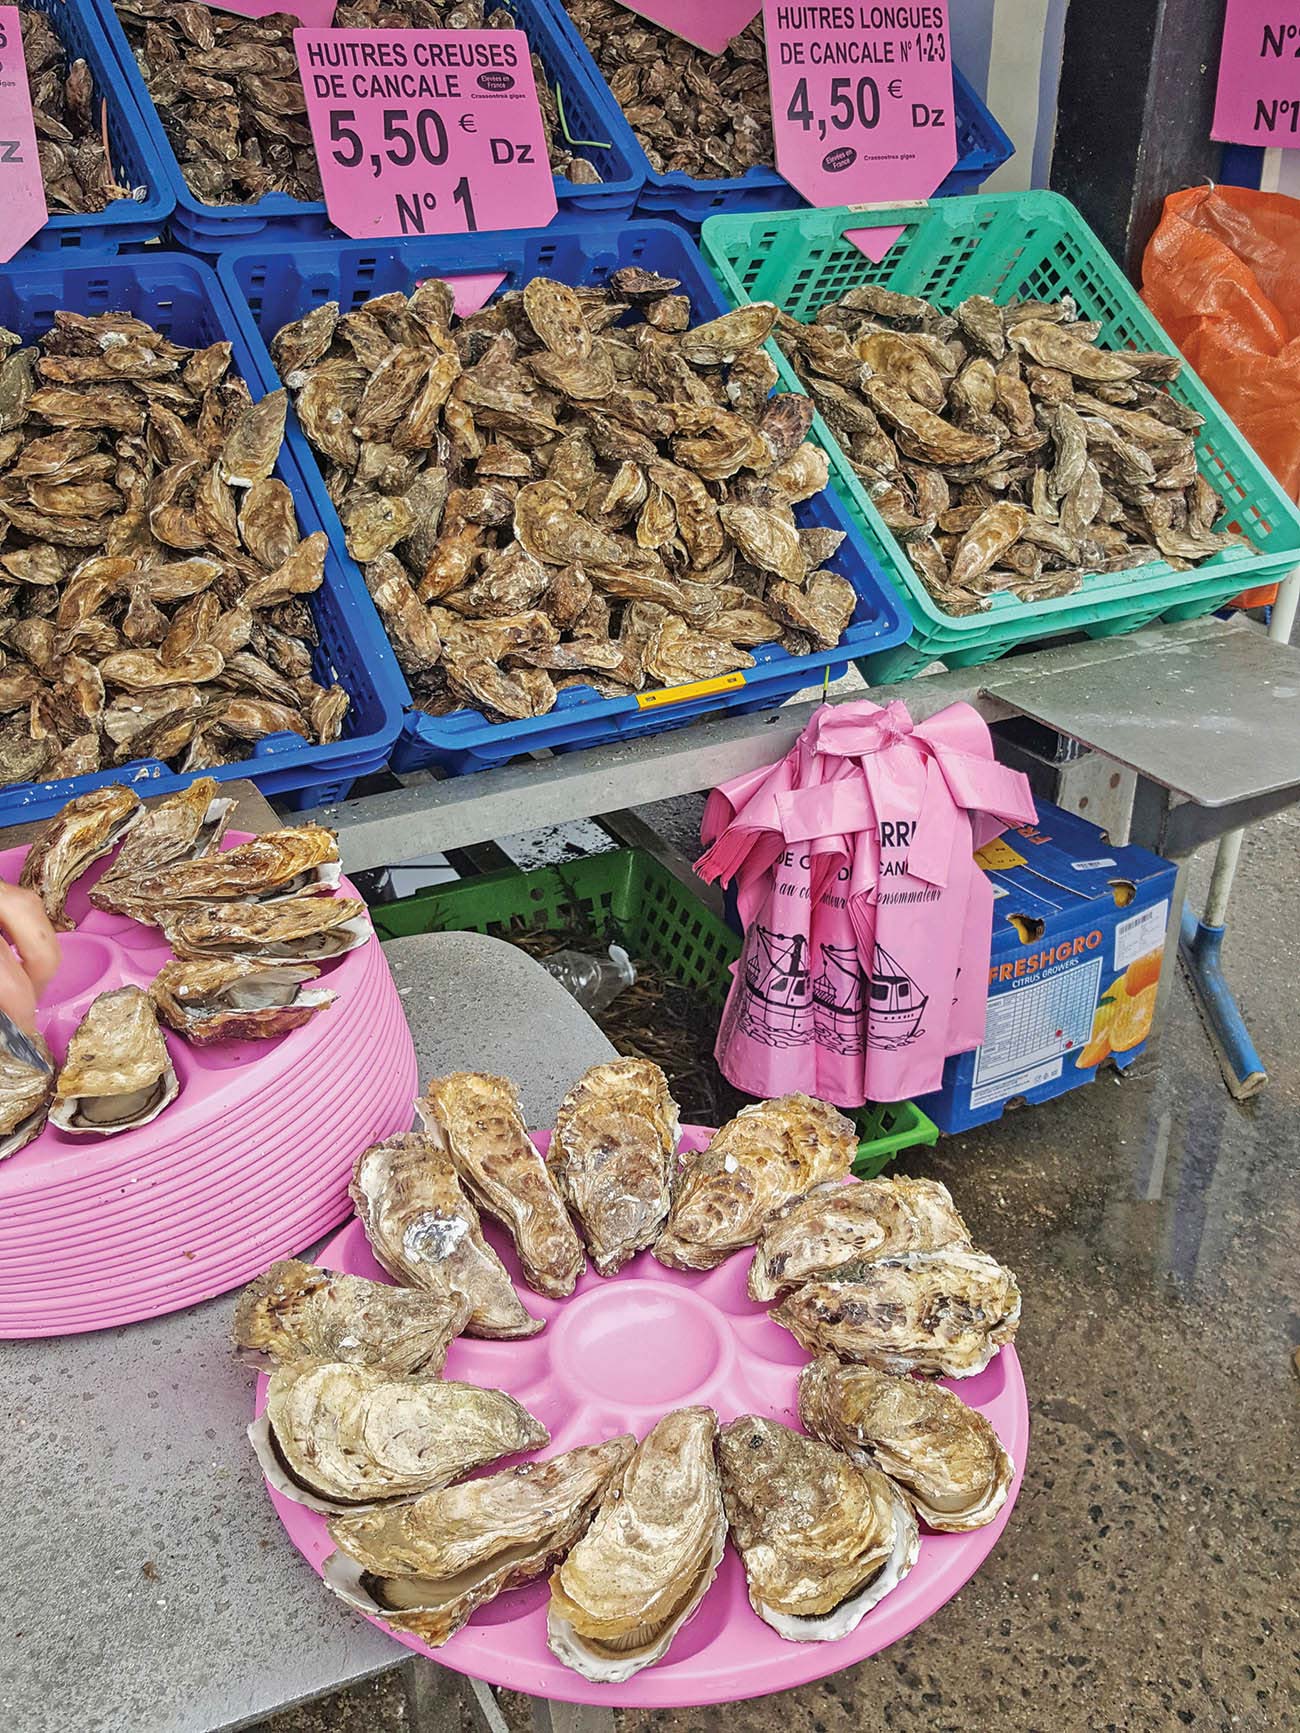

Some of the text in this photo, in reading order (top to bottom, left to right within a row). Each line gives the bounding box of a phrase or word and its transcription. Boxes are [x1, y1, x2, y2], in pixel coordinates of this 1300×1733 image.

[777, 7, 943, 29] HUITRES LONGUES
[307, 42, 518, 67] HUITRES CREUSES
[780, 42, 806, 65] DE
[810, 41, 895, 64] CANCALE
[1260, 25, 1300, 57] N°
[313, 74, 462, 98] DE CANCALE
[787, 76, 881, 141] 4,50
[911, 103, 945, 128] Dz
[329, 108, 449, 178] 5,50
[490, 138, 535, 164] Dz
[877, 884, 942, 905] onsommateur
[989, 930, 1103, 985] FRESHGRO
[1011, 958, 1080, 989] CITRUS GROWERS
